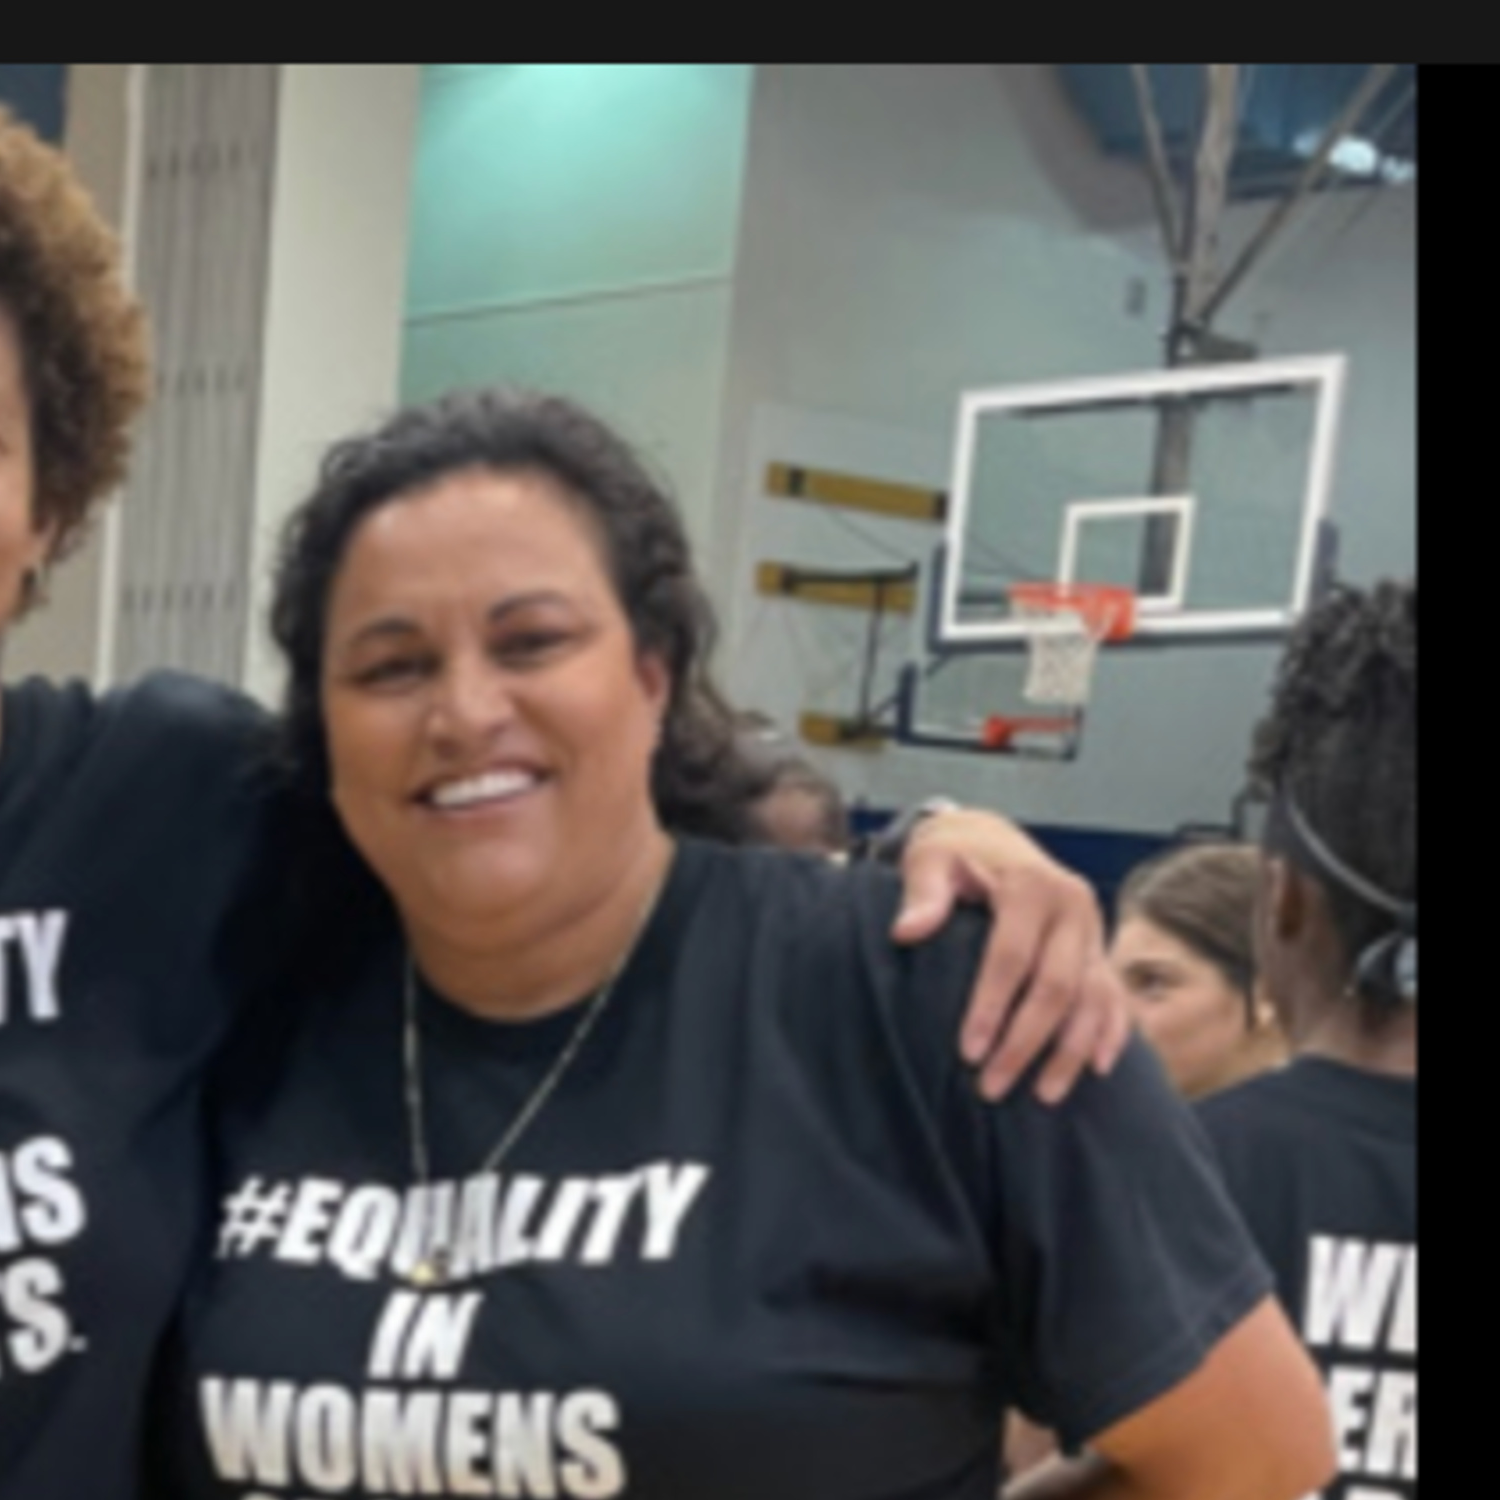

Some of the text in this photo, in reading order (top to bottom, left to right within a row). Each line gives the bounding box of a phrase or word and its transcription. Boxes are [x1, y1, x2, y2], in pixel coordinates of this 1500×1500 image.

[214, 1160, 710, 1283] #EQUALITY
[367, 1288, 484, 1381] IN
[200, 1376, 626, 1500] WOMENS
